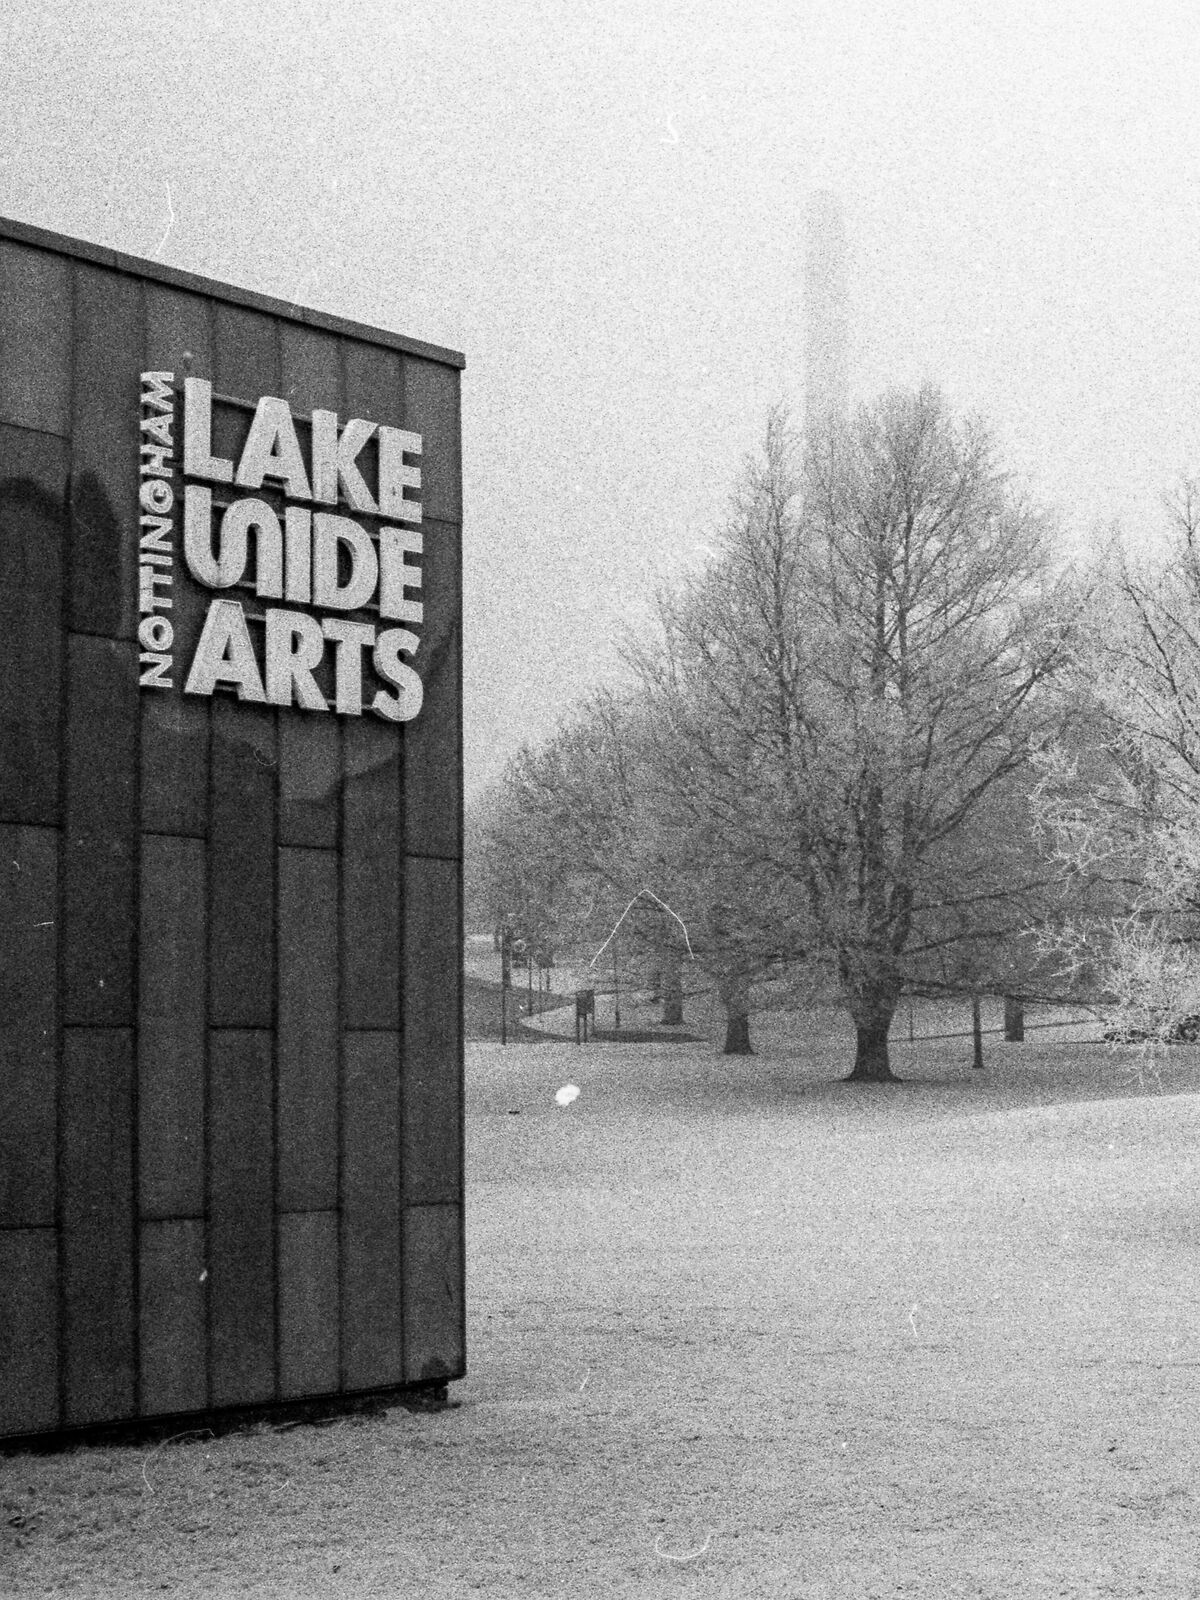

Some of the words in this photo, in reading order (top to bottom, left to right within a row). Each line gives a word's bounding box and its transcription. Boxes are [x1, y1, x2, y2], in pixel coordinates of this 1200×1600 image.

[184, 377, 422, 523] LAKE
[138, 371, 174, 688] NOTTINGHAM
[184, 599, 424, 722] ARTS
